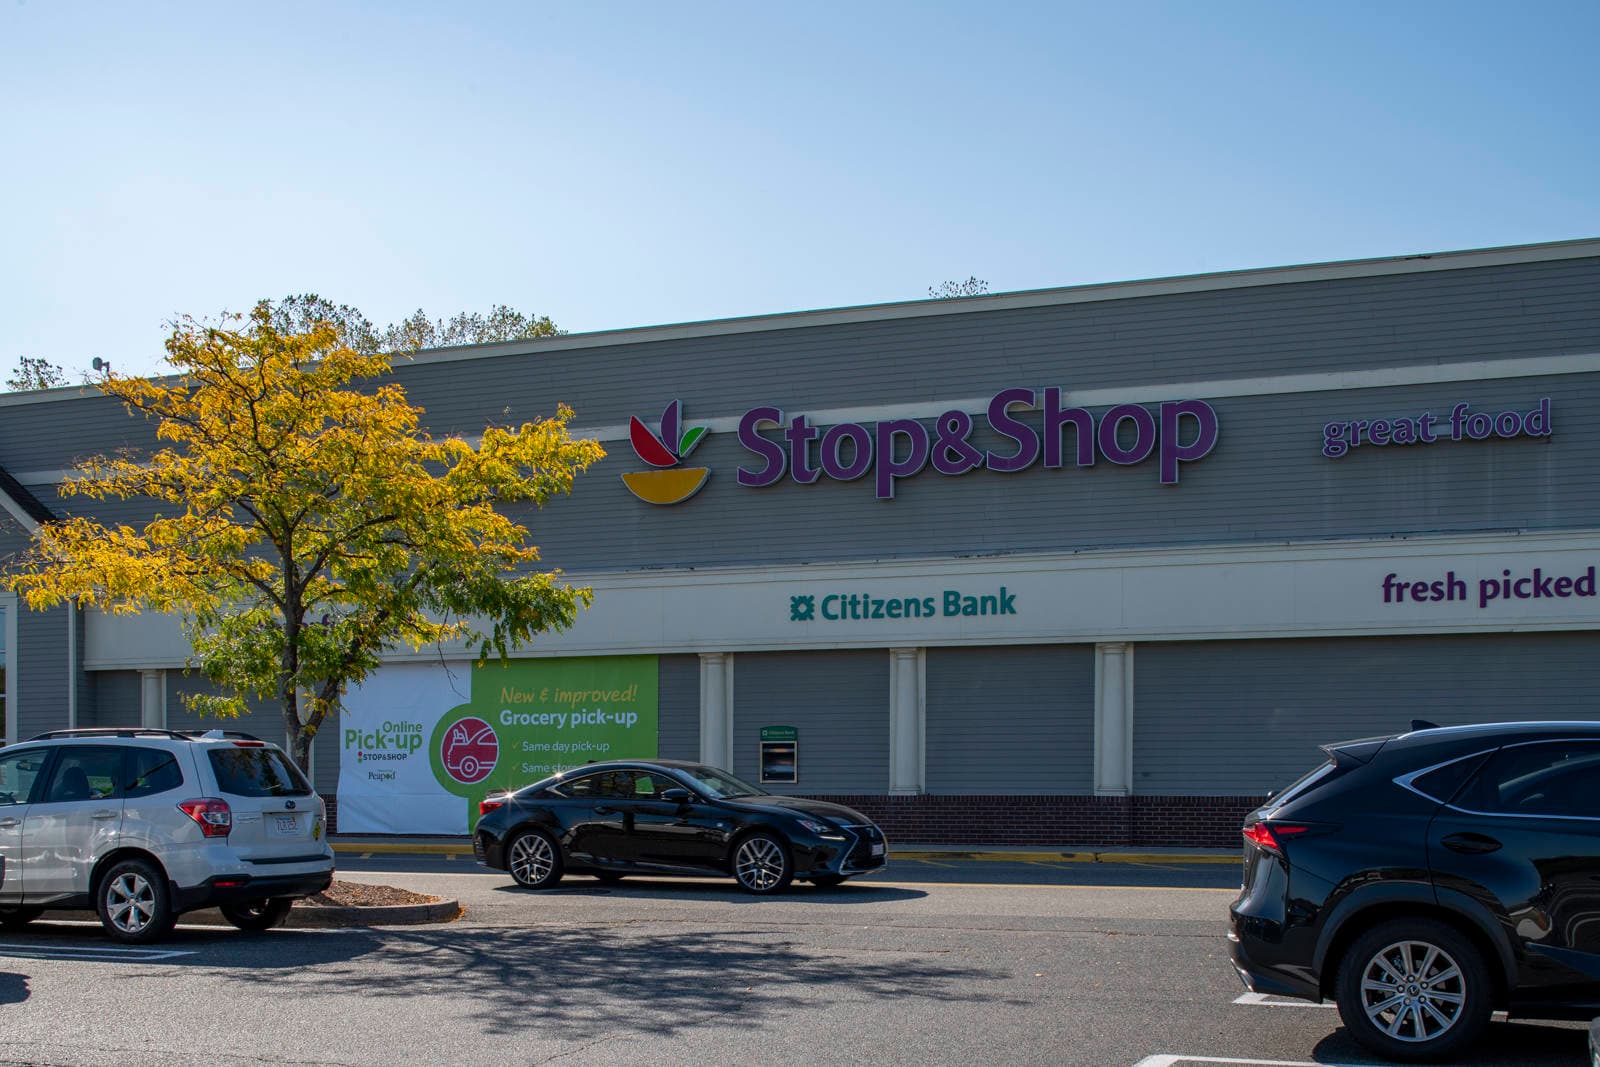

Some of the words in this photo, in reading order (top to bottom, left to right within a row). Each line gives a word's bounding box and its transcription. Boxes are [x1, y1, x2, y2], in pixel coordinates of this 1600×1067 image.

[1322, 411, 1438, 458] great
[1449, 396, 1552, 441] food
[736, 385, 1220, 500] Stop&Shop
[1382, 572, 1467, 604] fresh
[1479, 565, 1597, 608] picked
[821, 593, 936, 621] Citizens
[942, 586, 1017, 617] Bank
[500, 687, 536, 704] New
[554, 683, 638, 709] improved!
[382, 721, 423, 733] Online
[499, 709, 568, 729] Grocery
[570, 708, 638, 728] pick-up
[344, 728, 423, 755] Pick-up
[522, 741, 551, 752] Same
[552, 741, 571, 753] day
[571, 741, 610, 753] pick-up
[362, 753, 408, 761] STOP&SHOP
[522, 763, 550, 773] Same
